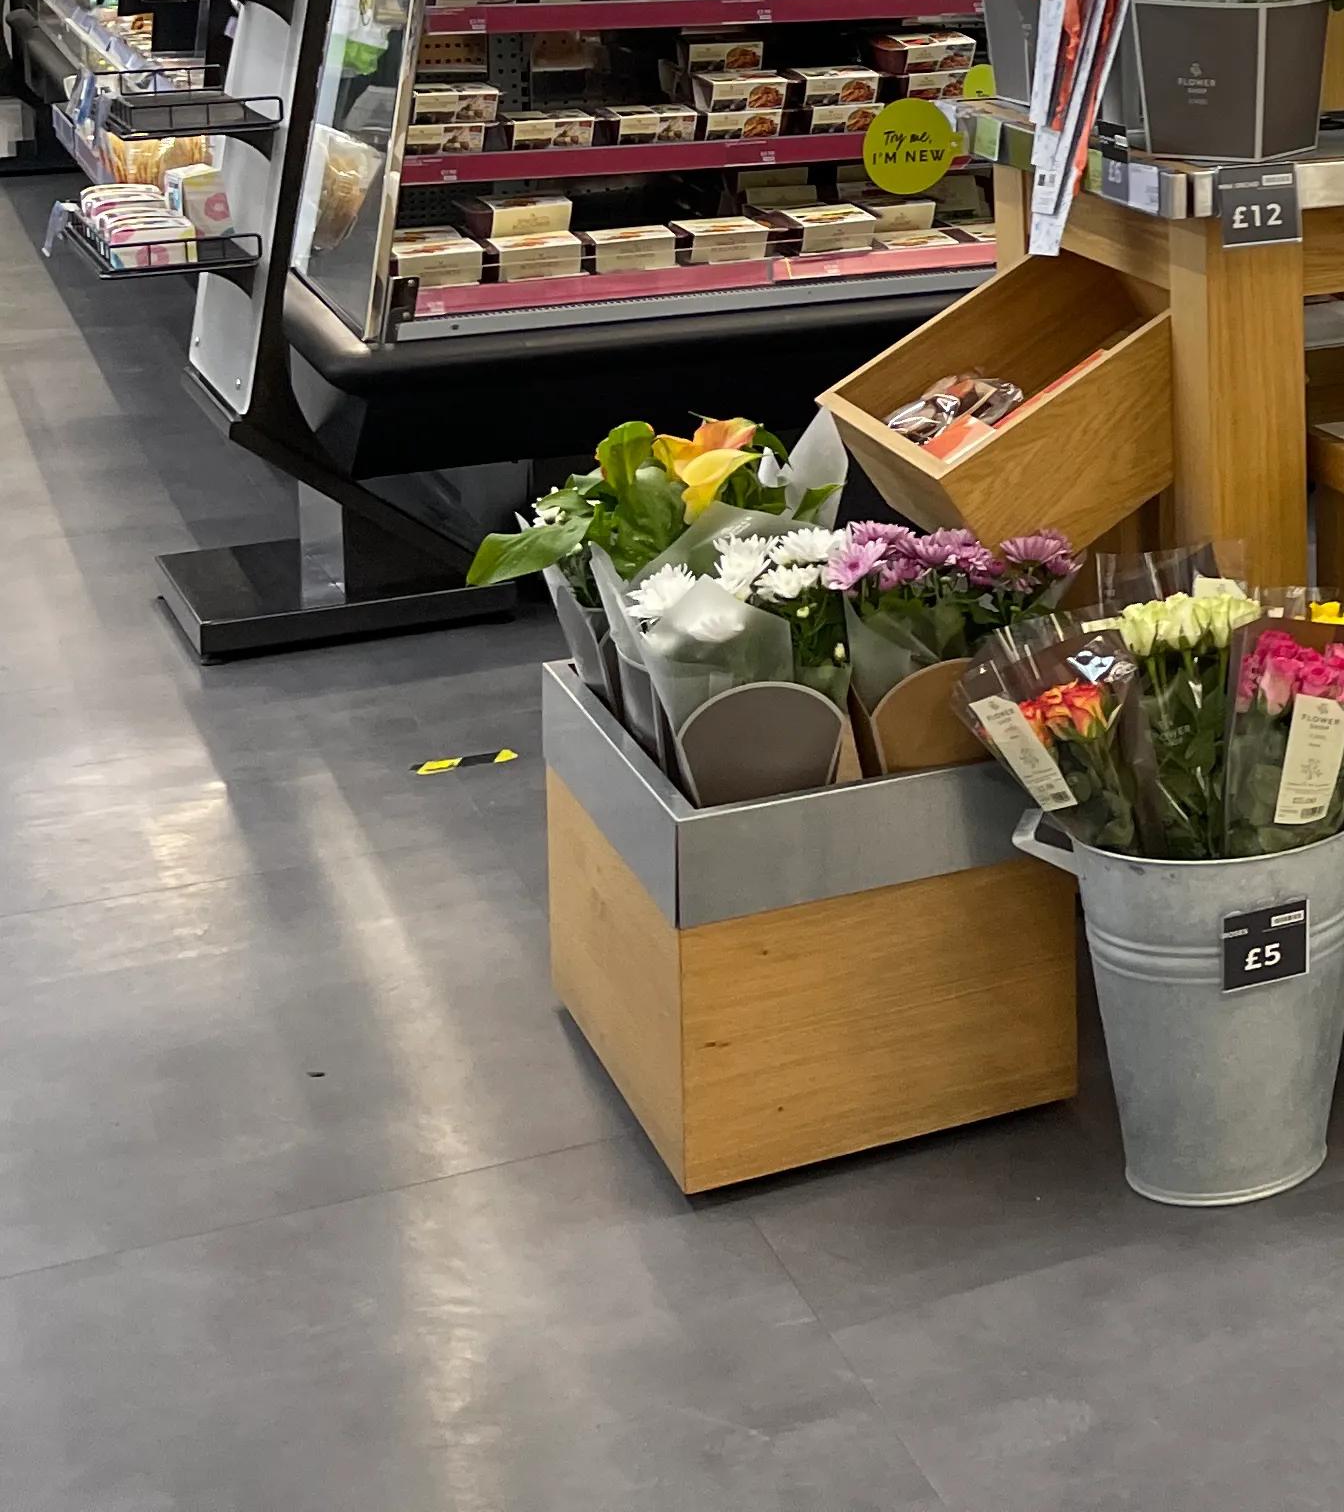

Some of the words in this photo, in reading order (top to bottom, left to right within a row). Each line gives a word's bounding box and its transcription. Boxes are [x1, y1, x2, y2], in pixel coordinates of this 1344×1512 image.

[1177, 77, 1216, 87] FLOWER
[884, 130, 905, 151] Try
[872, 151, 897, 165] I'M
[905, 149, 945, 163] NEW
[1232, 203, 1282, 229] £12
[1301, 714, 1340, 725] FLOWER
[1221, 928, 1248, 939] ROSES
[1244, 943, 1281, 971] £5
